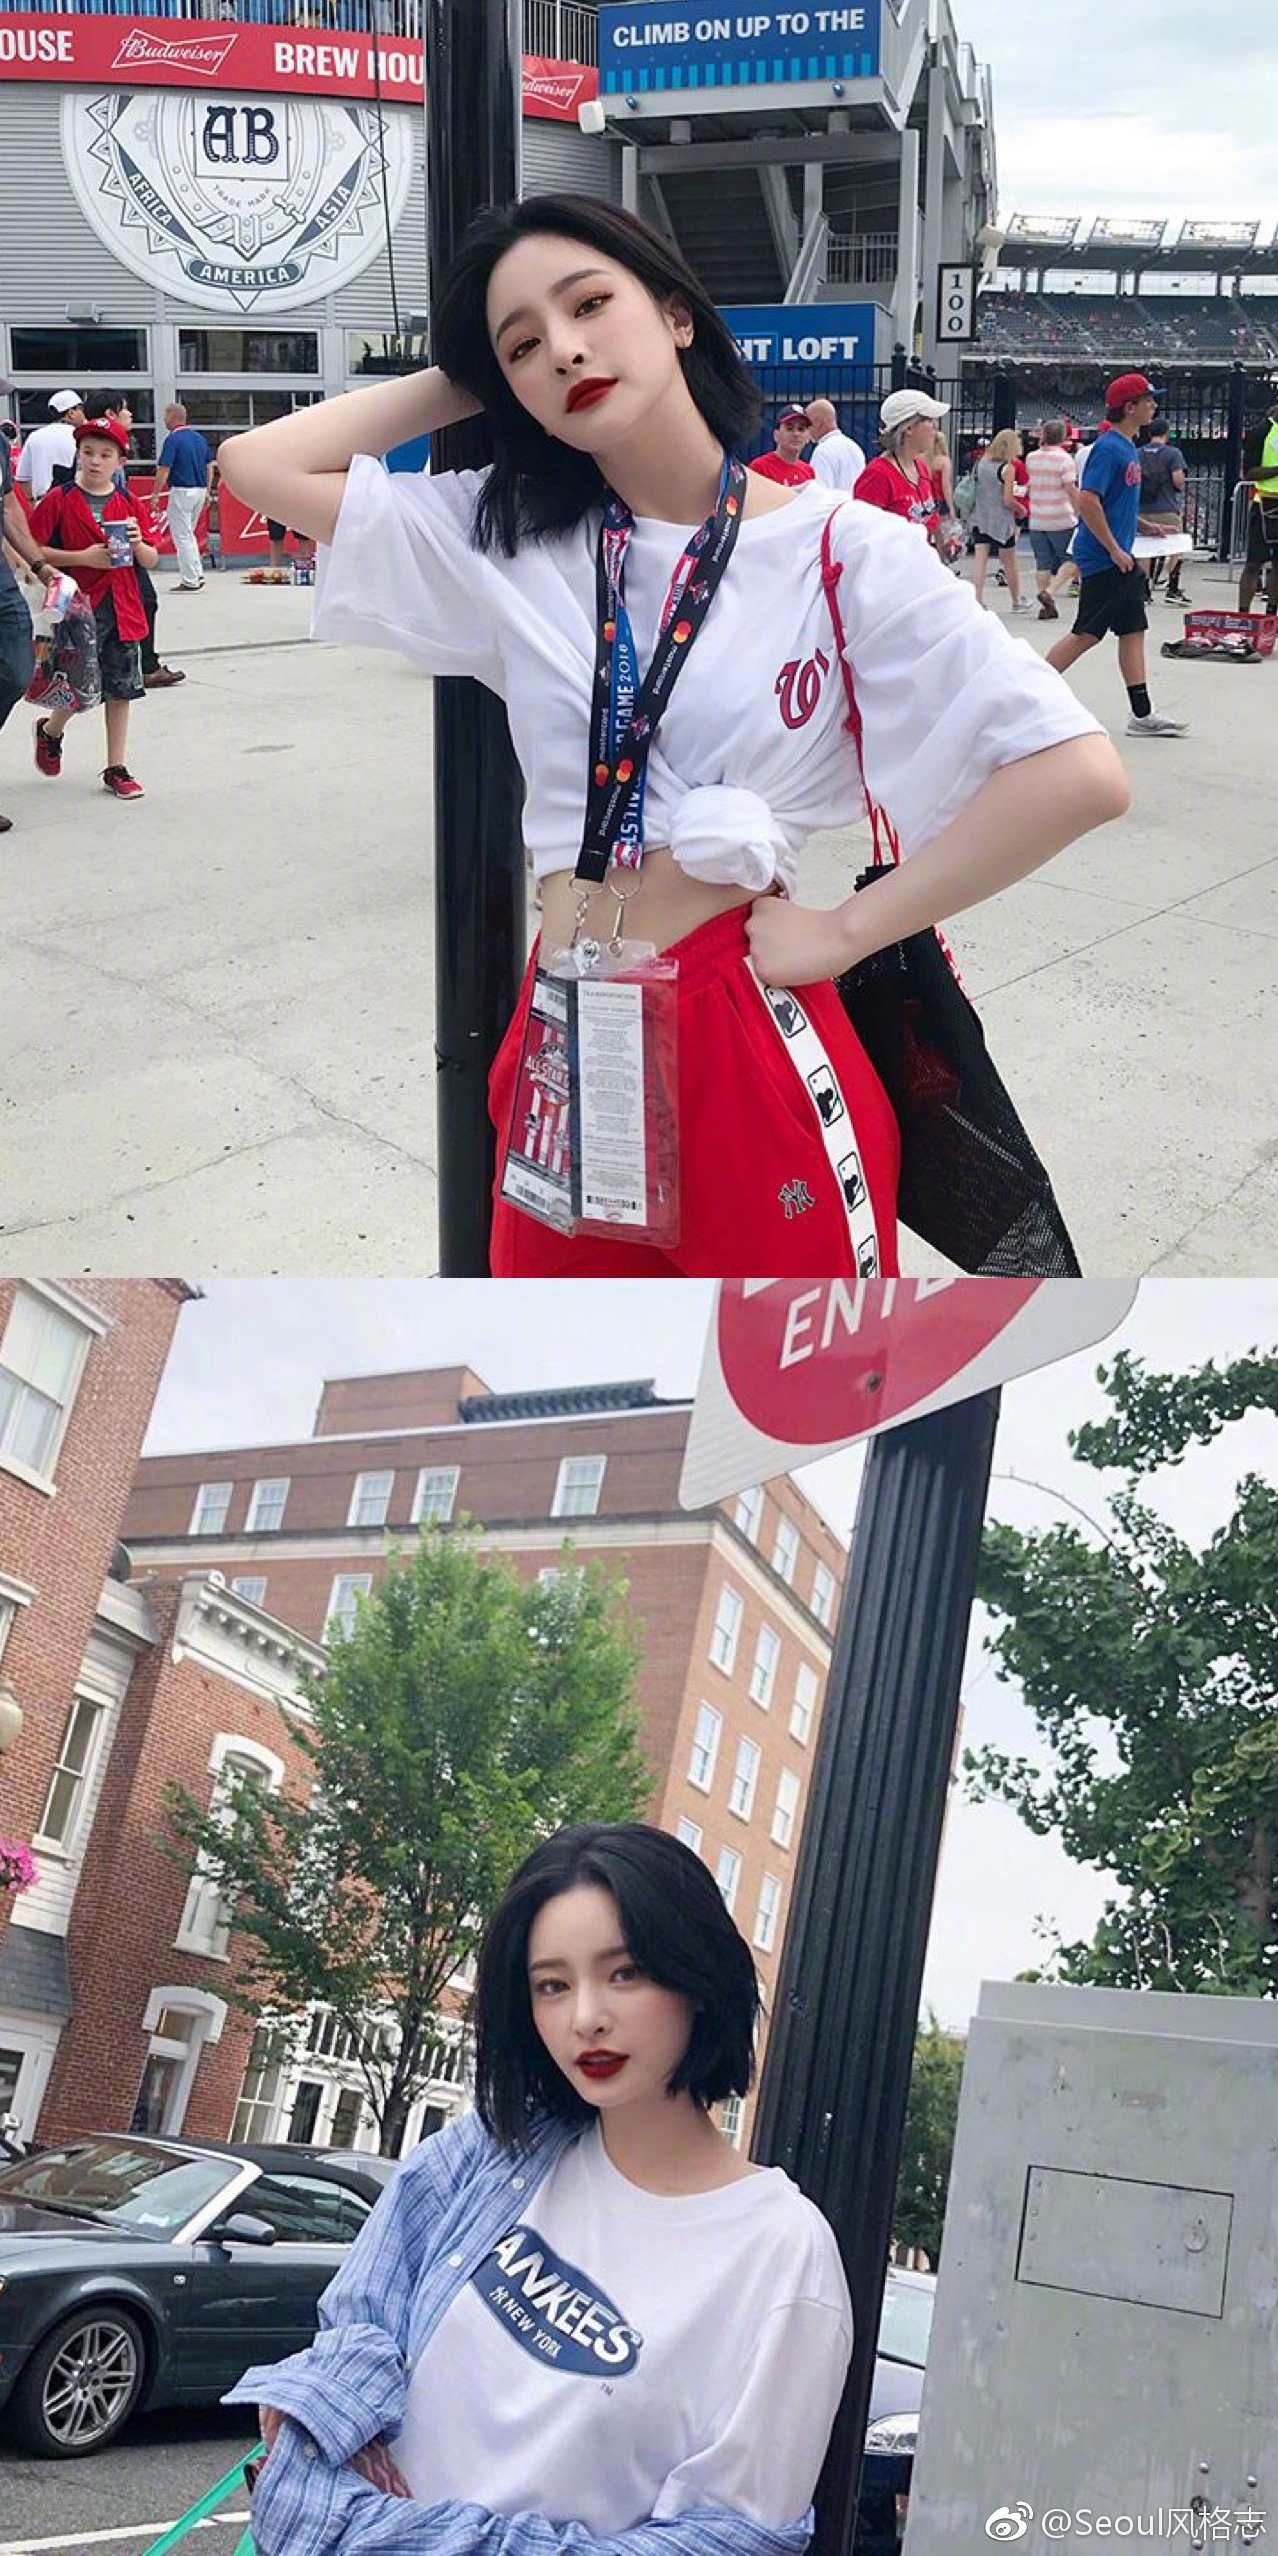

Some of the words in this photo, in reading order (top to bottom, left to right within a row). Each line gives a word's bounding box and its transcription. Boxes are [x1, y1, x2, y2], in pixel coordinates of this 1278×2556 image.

[613, 22, 690, 47] CLIMB
[695, 20, 731, 42] ON
[736, 15, 771, 37] UP
[775, 13, 810, 34] TO
[815, 9, 865, 31] THE
[122, 38, 224, 62] Budweiser
[274, 43, 359, 79] BREW
[203, 105, 279, 165] AB
[128, 173, 173, 226] AFRICA
[212, 183, 242, 208] TRADE
[247, 187, 272, 208] MARK
[314, 185, 352, 230] ASIA
[199, 265, 291, 285] AMERICA
[947, 273, 964, 332] 100
[782, 336, 858, 361] LOFT
[493, 2227, 644, 2363] ANKEES
[503, 2298, 535, 2332] NEW
